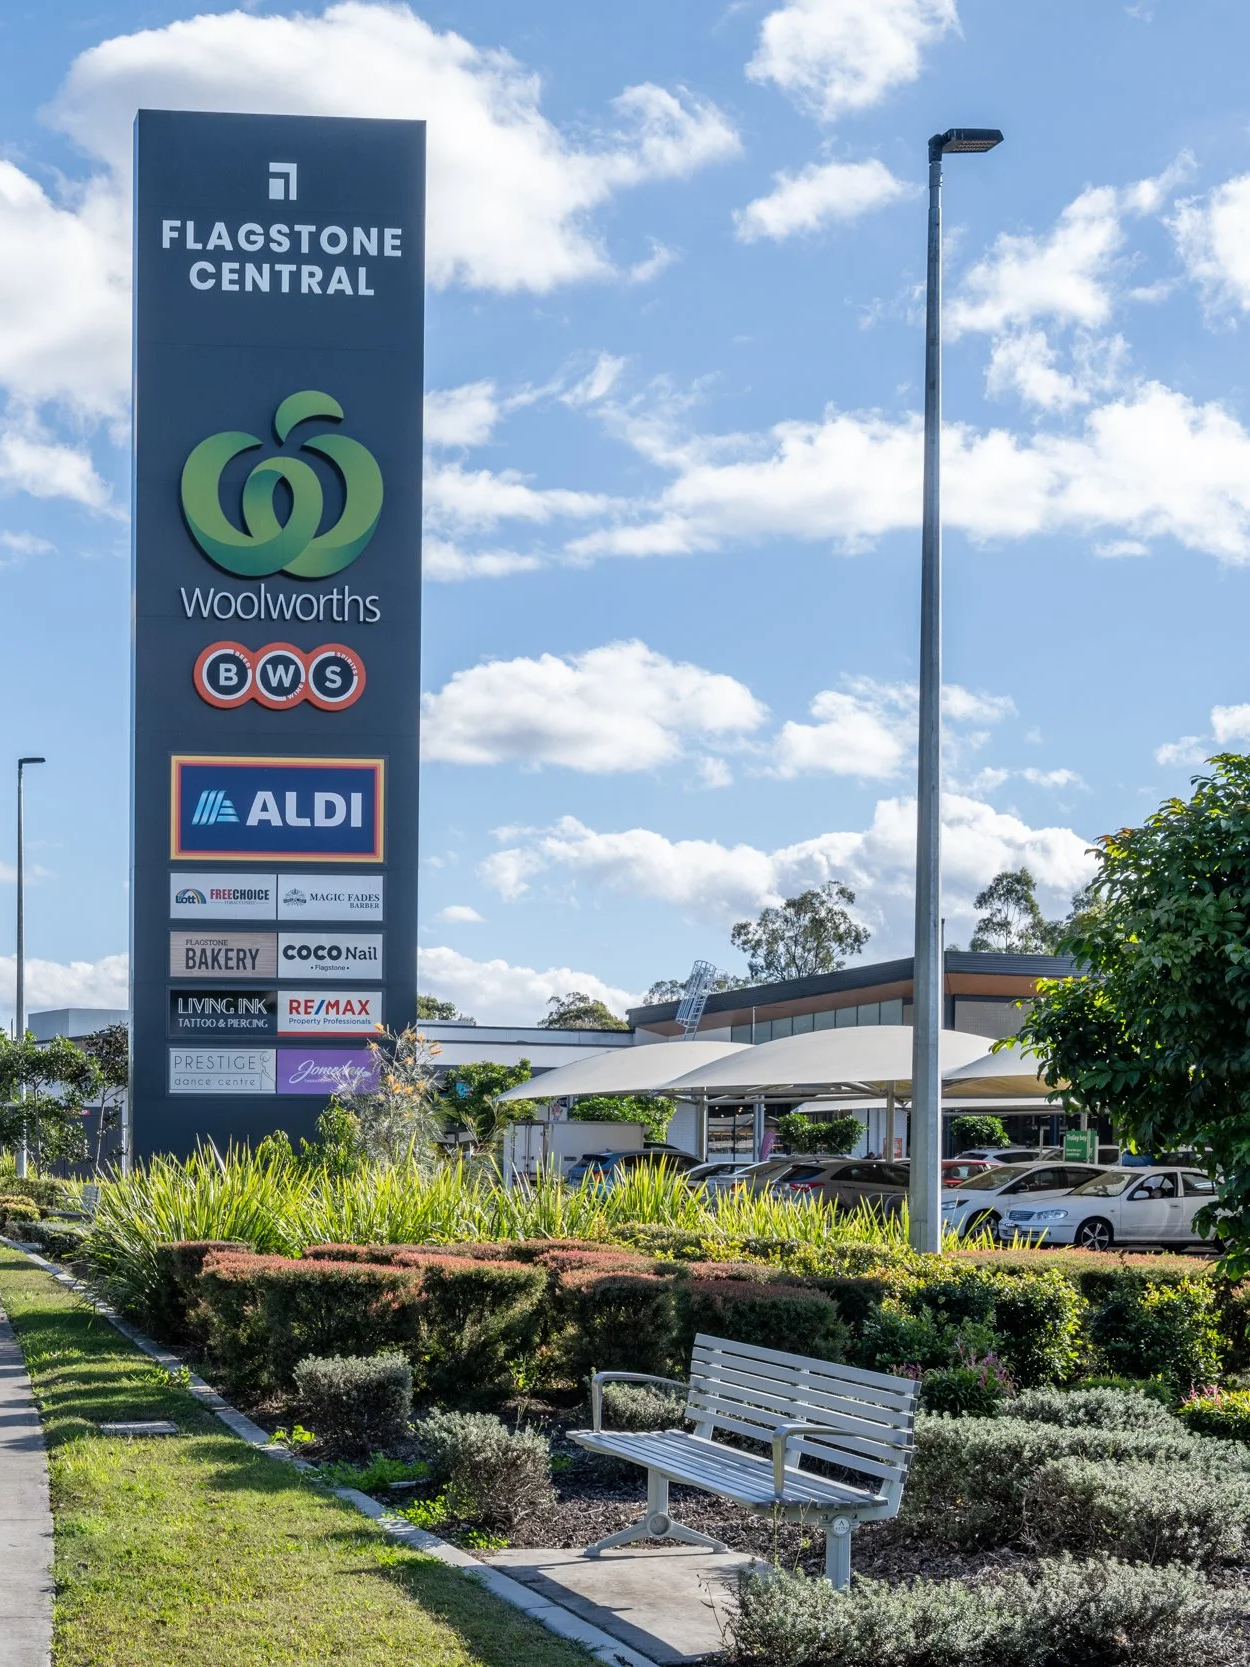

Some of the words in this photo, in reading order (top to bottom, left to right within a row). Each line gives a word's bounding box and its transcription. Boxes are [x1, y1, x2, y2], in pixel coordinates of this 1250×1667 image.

[162, 220, 402, 257] FLAGSTONE
[189, 261, 375, 296] CENTRAL
[180, 583, 381, 622] Woolworths
[235, 650, 251, 668] BEER
[336, 651, 358, 675] SPIRITS
[287, 682, 304, 700] WINE
[246, 791, 362, 828] ALDI
[210, 888, 270, 901] FREECHOICE
[310, 893, 345, 902] MAGIC
[347, 893, 380, 902] FADES
[185, 939, 229, 947] FLAGSTONE
[185, 947, 260, 971] BAKERY
[282, 944, 343, 961] COCO
[344, 946, 378, 961] Nail
[314, 964, 346, 972] Flagstone
[178, 997, 235, 1014] LIVING
[238, 998, 268, 1015] INK
[289, 999, 371, 1016] RE/MAX
[178, 1018, 217, 1028] TATTOO
[217, 1019, 226, 1028] &
[227, 1018, 268, 1028] PIERCING
[289, 1017, 321, 1025] Property
[323, 1017, 372, 1025] Professionals
[174, 1055, 256, 1070] PRESTIGE
[174, 1077, 211, 1086] dance
[217, 1077, 256, 1086] centre
